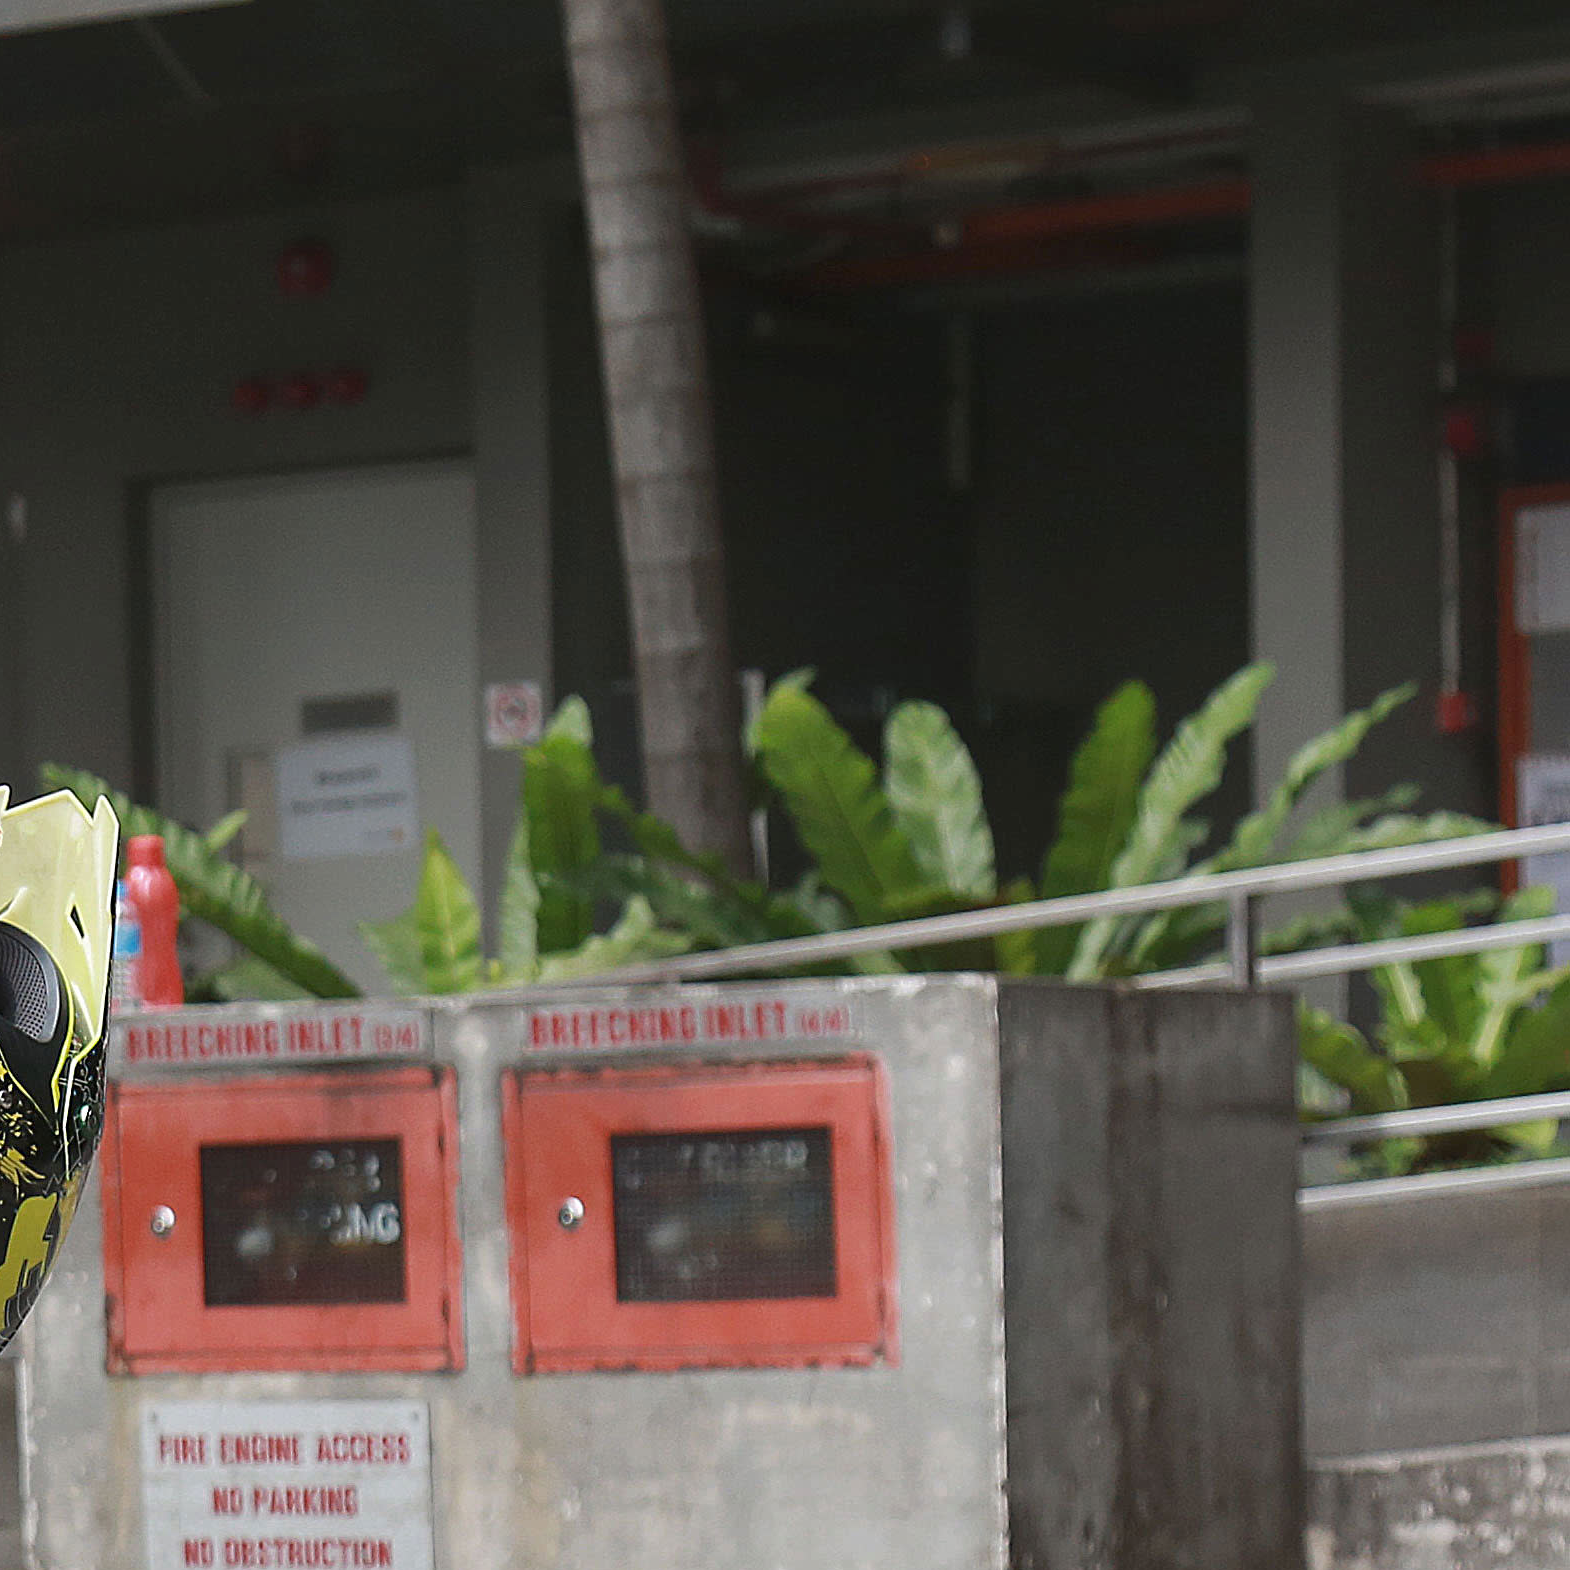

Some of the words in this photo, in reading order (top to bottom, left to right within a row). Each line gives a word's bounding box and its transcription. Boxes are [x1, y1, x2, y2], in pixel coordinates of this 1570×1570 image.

[128, 1019, 279, 1062] BREECHING
[287, 1016, 364, 1055] INLET
[530, 1006, 697, 1047] BREECHING
[704, 1001, 787, 1039] INLET
[159, 1434, 205, 1465] FIRE
[220, 1433, 300, 1465] ENGINE
[315, 1432, 410, 1464] ACCESS
[212, 1485, 243, 1516] NO
[252, 1484, 359, 1516] PARKING
[181, 1537, 213, 1568] NO
[223, 1536, 394, 1570] OBSTRUCTION
